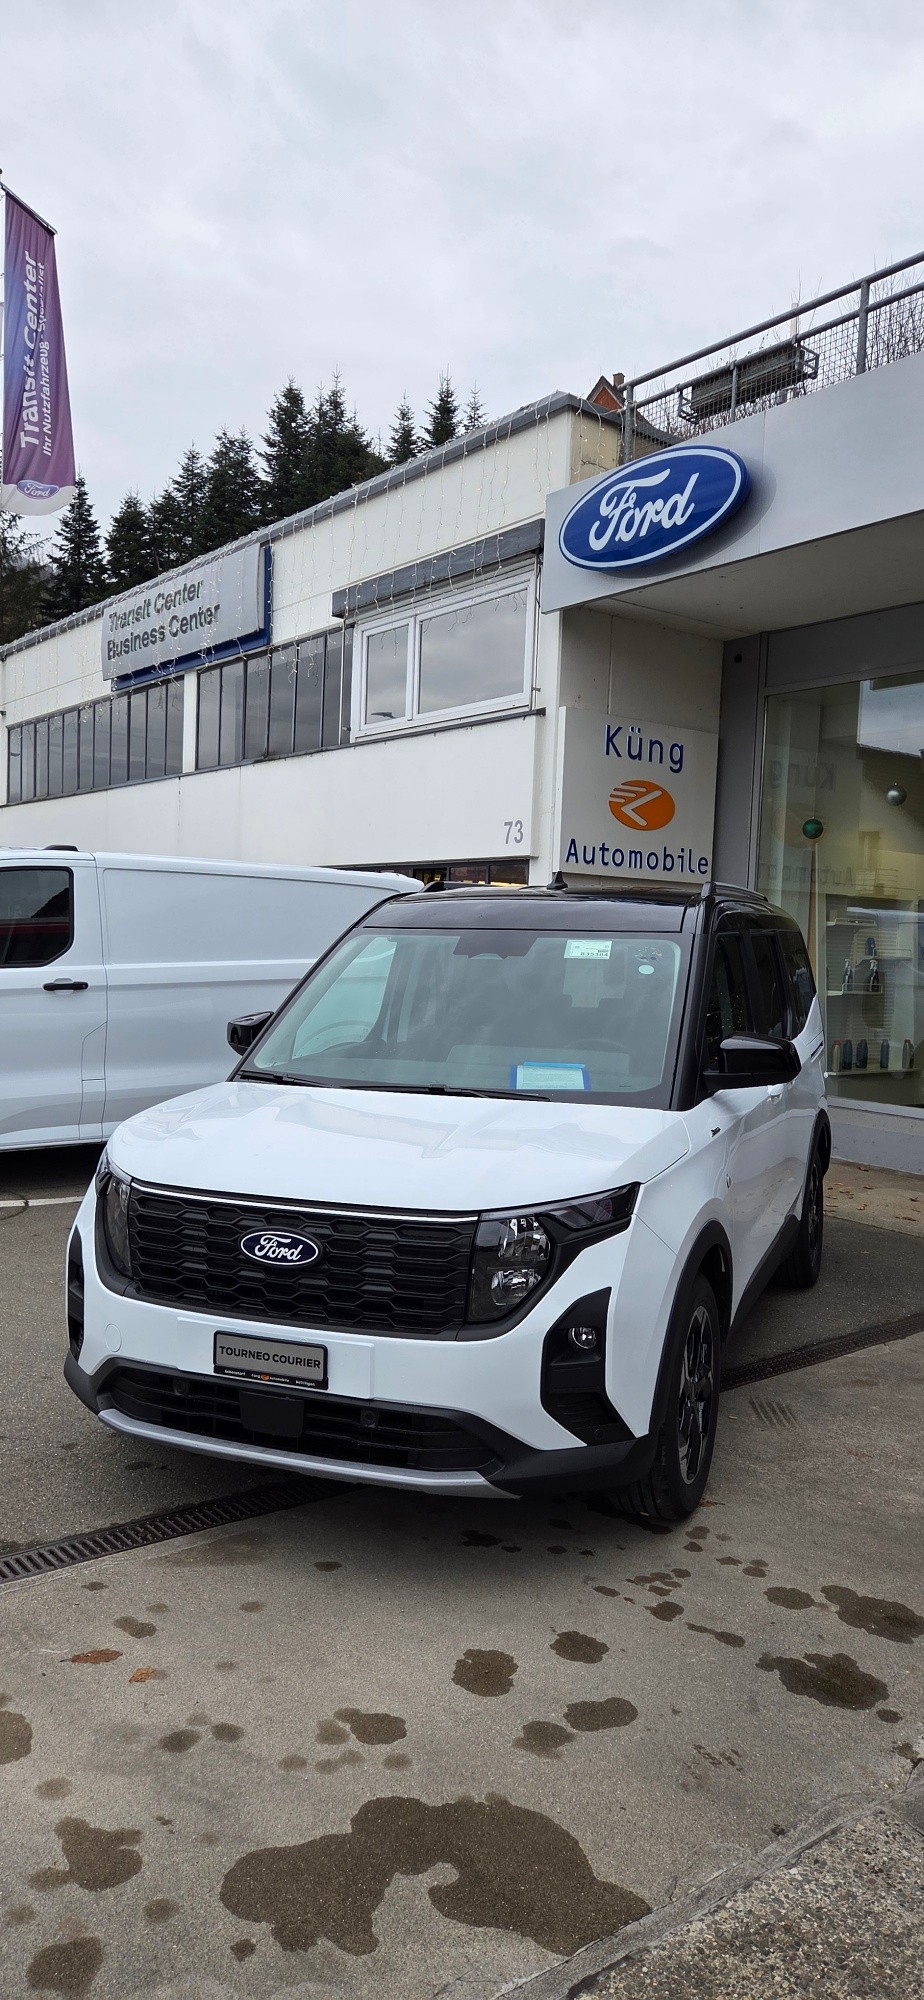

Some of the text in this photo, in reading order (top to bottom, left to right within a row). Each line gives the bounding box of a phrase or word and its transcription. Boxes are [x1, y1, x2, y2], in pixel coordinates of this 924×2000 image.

[19, 250, 39, 448] Transit Center
[39, 341, 52, 435] Nutzfahrzeug
[43, 436, 52, 456] Ihr
[24, 482, 50, 497] Ford
[588, 468, 700, 551] Ford
[109, 580, 204, 632] Transit Center
[107, 604, 220, 661] Business Center
[605, 724, 684, 773] Küng
[503, 820, 524, 845] 73
[565, 838, 709, 875] Automobile
[254, 1234, 304, 1261] Ford
[219, 1345, 321, 1369] TOURNEO COURIER
